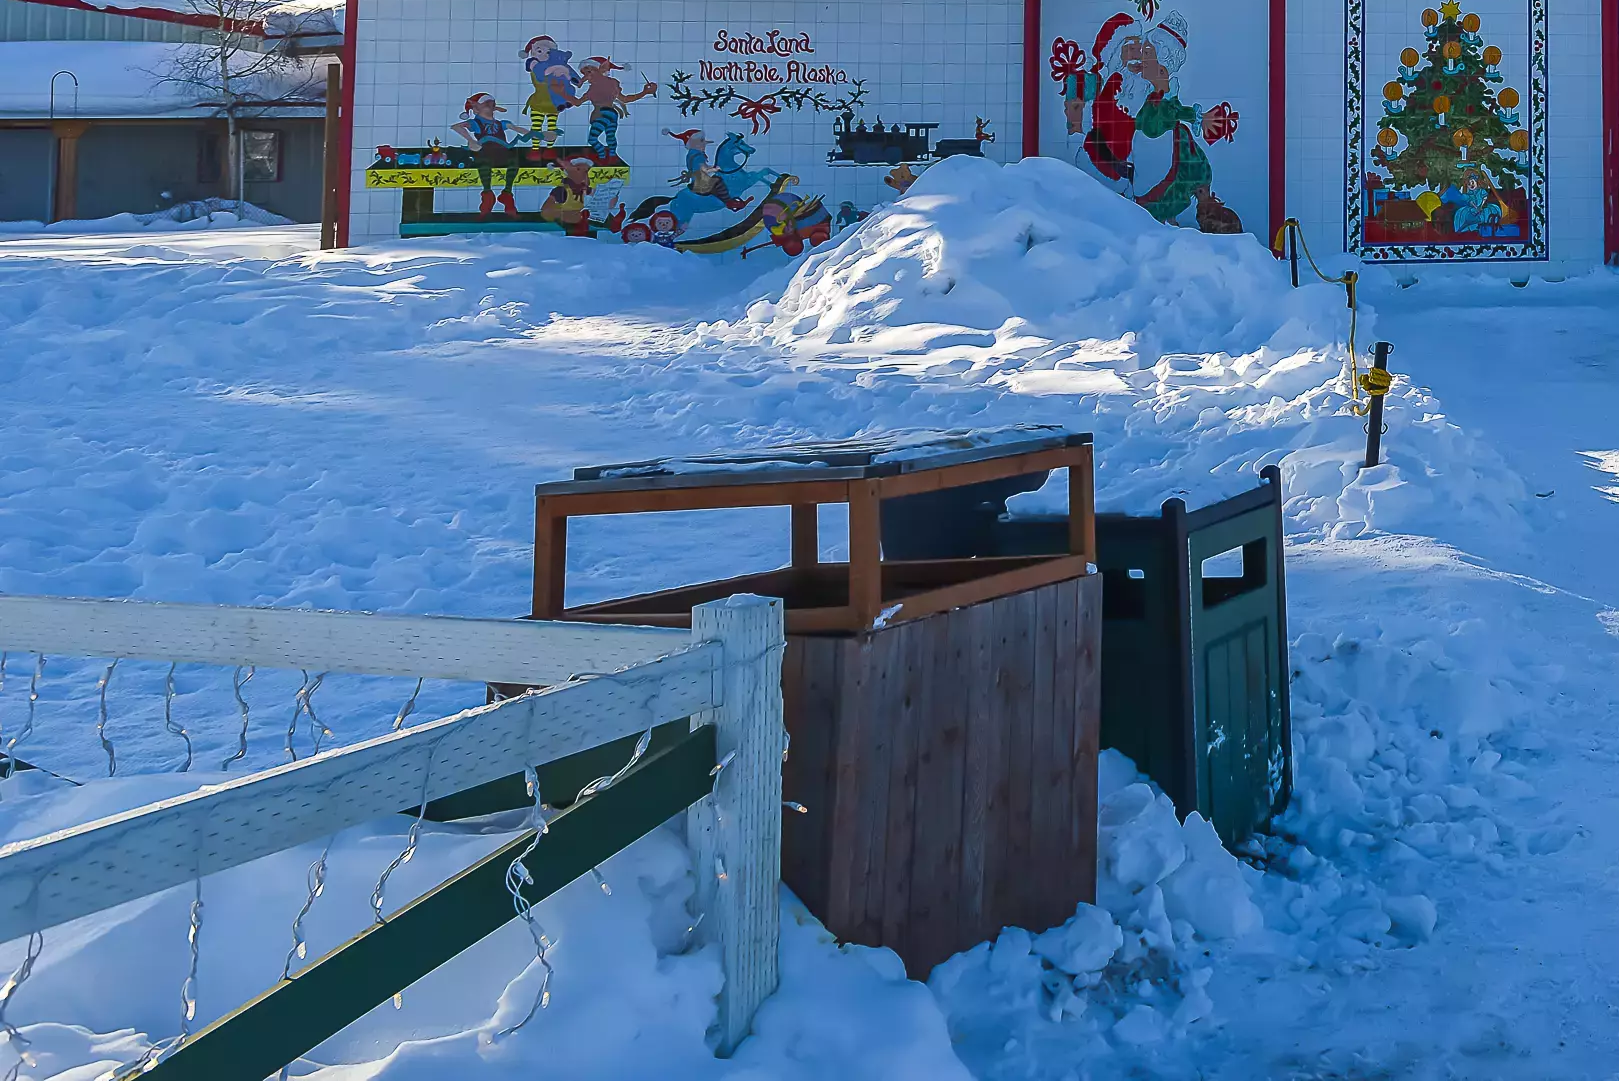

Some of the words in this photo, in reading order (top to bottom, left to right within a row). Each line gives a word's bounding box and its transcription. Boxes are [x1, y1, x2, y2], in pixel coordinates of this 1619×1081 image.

[713, 29, 766, 55] Santa
[766, 29, 815, 57] Land
[699, 60, 744, 82] North
[744, 60, 783, 83] Pole,
[786, 60, 848, 85] Alaska
